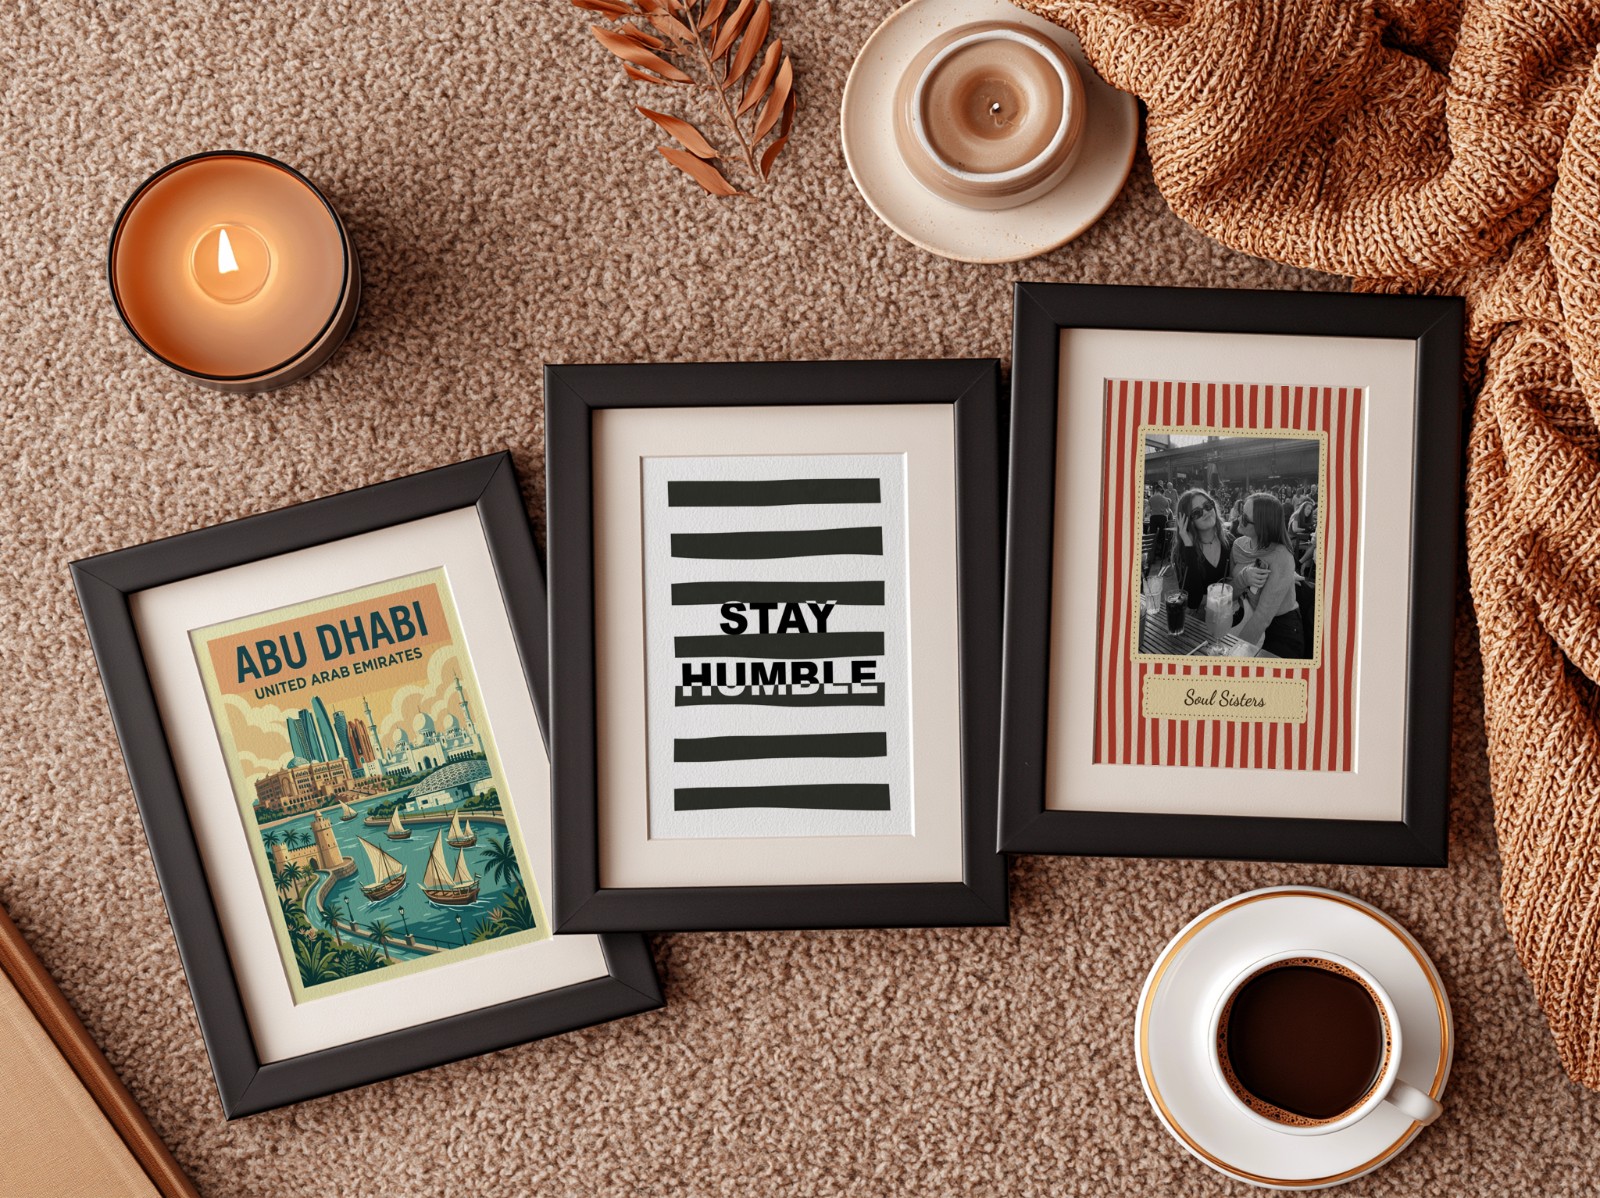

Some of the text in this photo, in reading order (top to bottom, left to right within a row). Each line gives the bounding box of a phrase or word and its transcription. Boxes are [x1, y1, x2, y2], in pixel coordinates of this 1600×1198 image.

[719, 600, 838, 635] STAY
[236, 600, 429, 683] ABU DHABI
[254, 647, 423, 700] UNITED ARAB EMIRATES
[681, 660, 878, 697] HUMBLE
[1184, 688, 1266, 708] Soul Sisters
